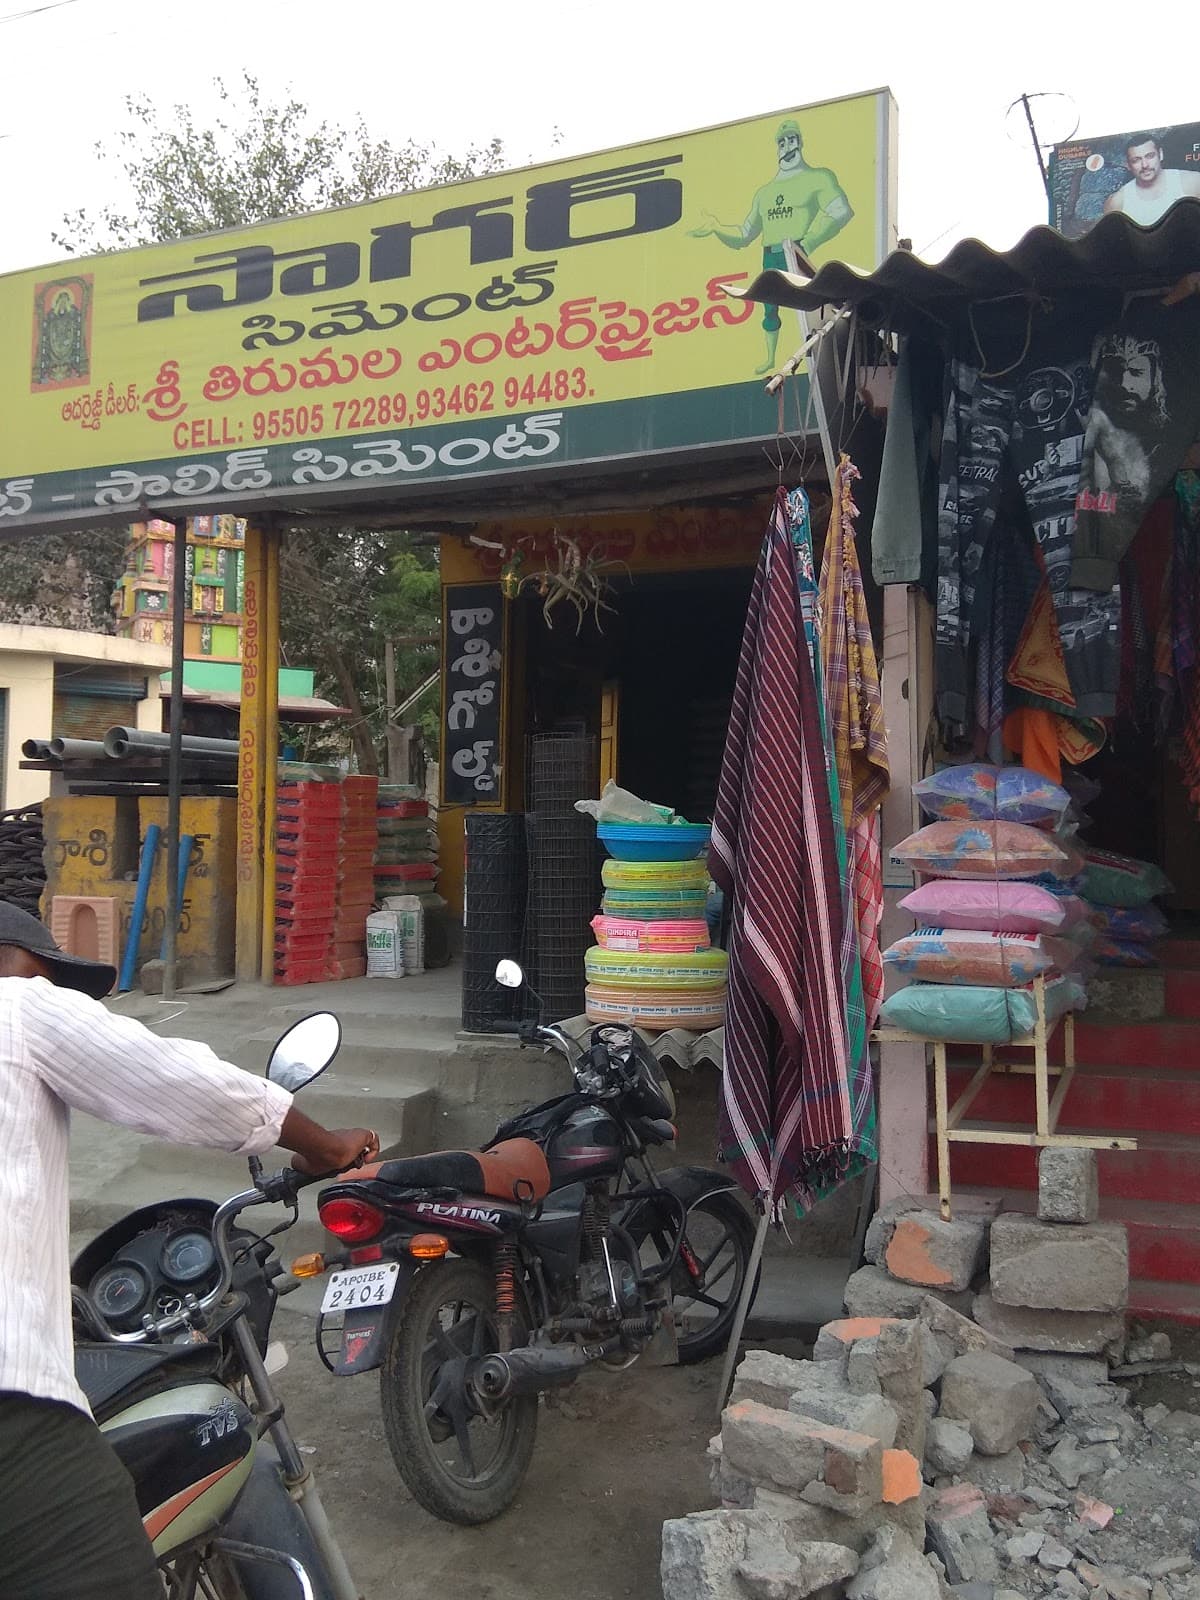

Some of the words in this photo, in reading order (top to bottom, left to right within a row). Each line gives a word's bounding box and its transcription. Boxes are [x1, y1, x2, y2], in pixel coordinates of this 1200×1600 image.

[767, 206, 794, 217] SAGAR
[137, 154, 683, 323] సాగర్
[242, 260, 558, 350] సిమెంట్
[142, 360, 188, 422] శ్రీ
[202, 346, 401, 402] తిరుమల
[173, 417, 243, 450] CELL:
[253, 405, 324, 440] 95505
[94, 448, 272, 506] సాలిడ్
[291, 412, 563, 484] సిమెంట్
[416, 1201, 501, 1223] PLATINA
[329, 1283, 385, 1308] 2404
[198, 1410, 238, 1446] TVS
